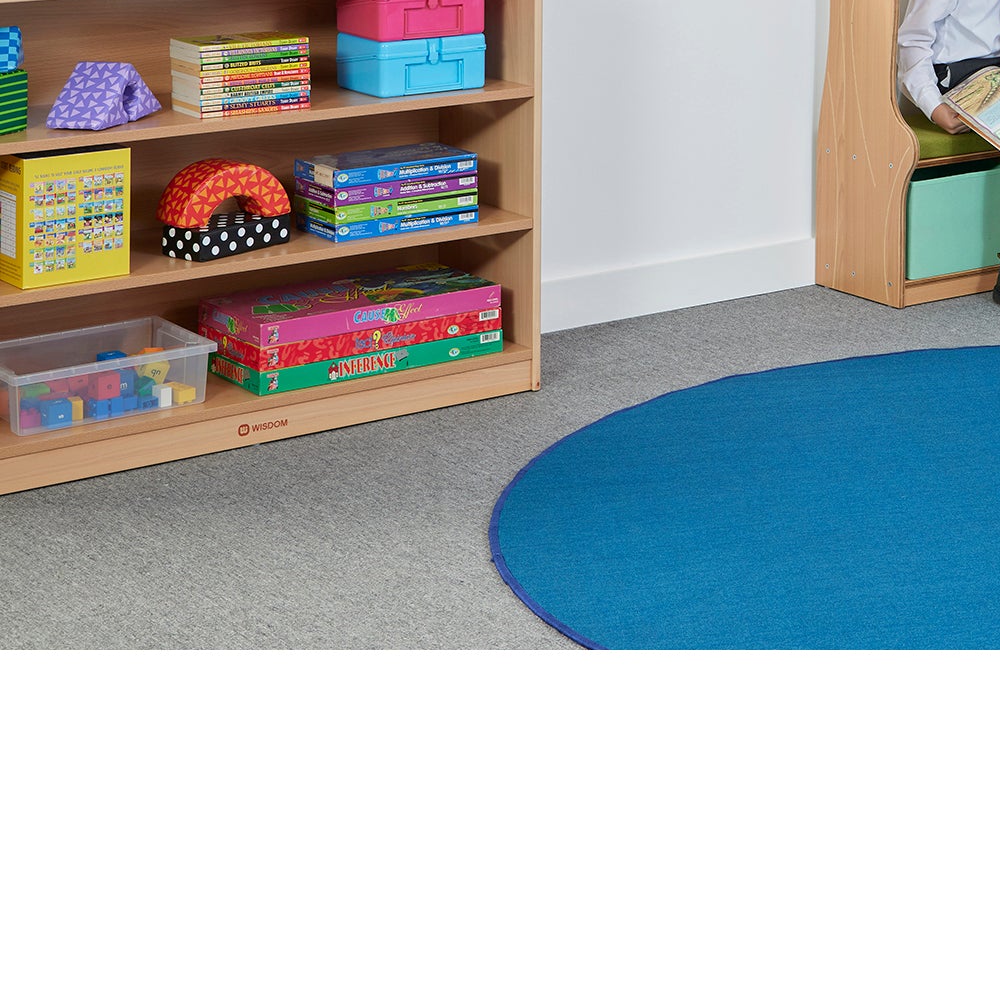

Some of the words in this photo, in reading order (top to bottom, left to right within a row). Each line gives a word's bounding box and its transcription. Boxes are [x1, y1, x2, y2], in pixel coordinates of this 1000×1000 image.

[400, 219, 431, 228] Multiplication
[354, 308, 386, 324] CAUSE
[395, 303, 423, 320] Effect
[339, 352, 396, 377] INFERENCE
[252, 419, 288, 432] WISDOM
